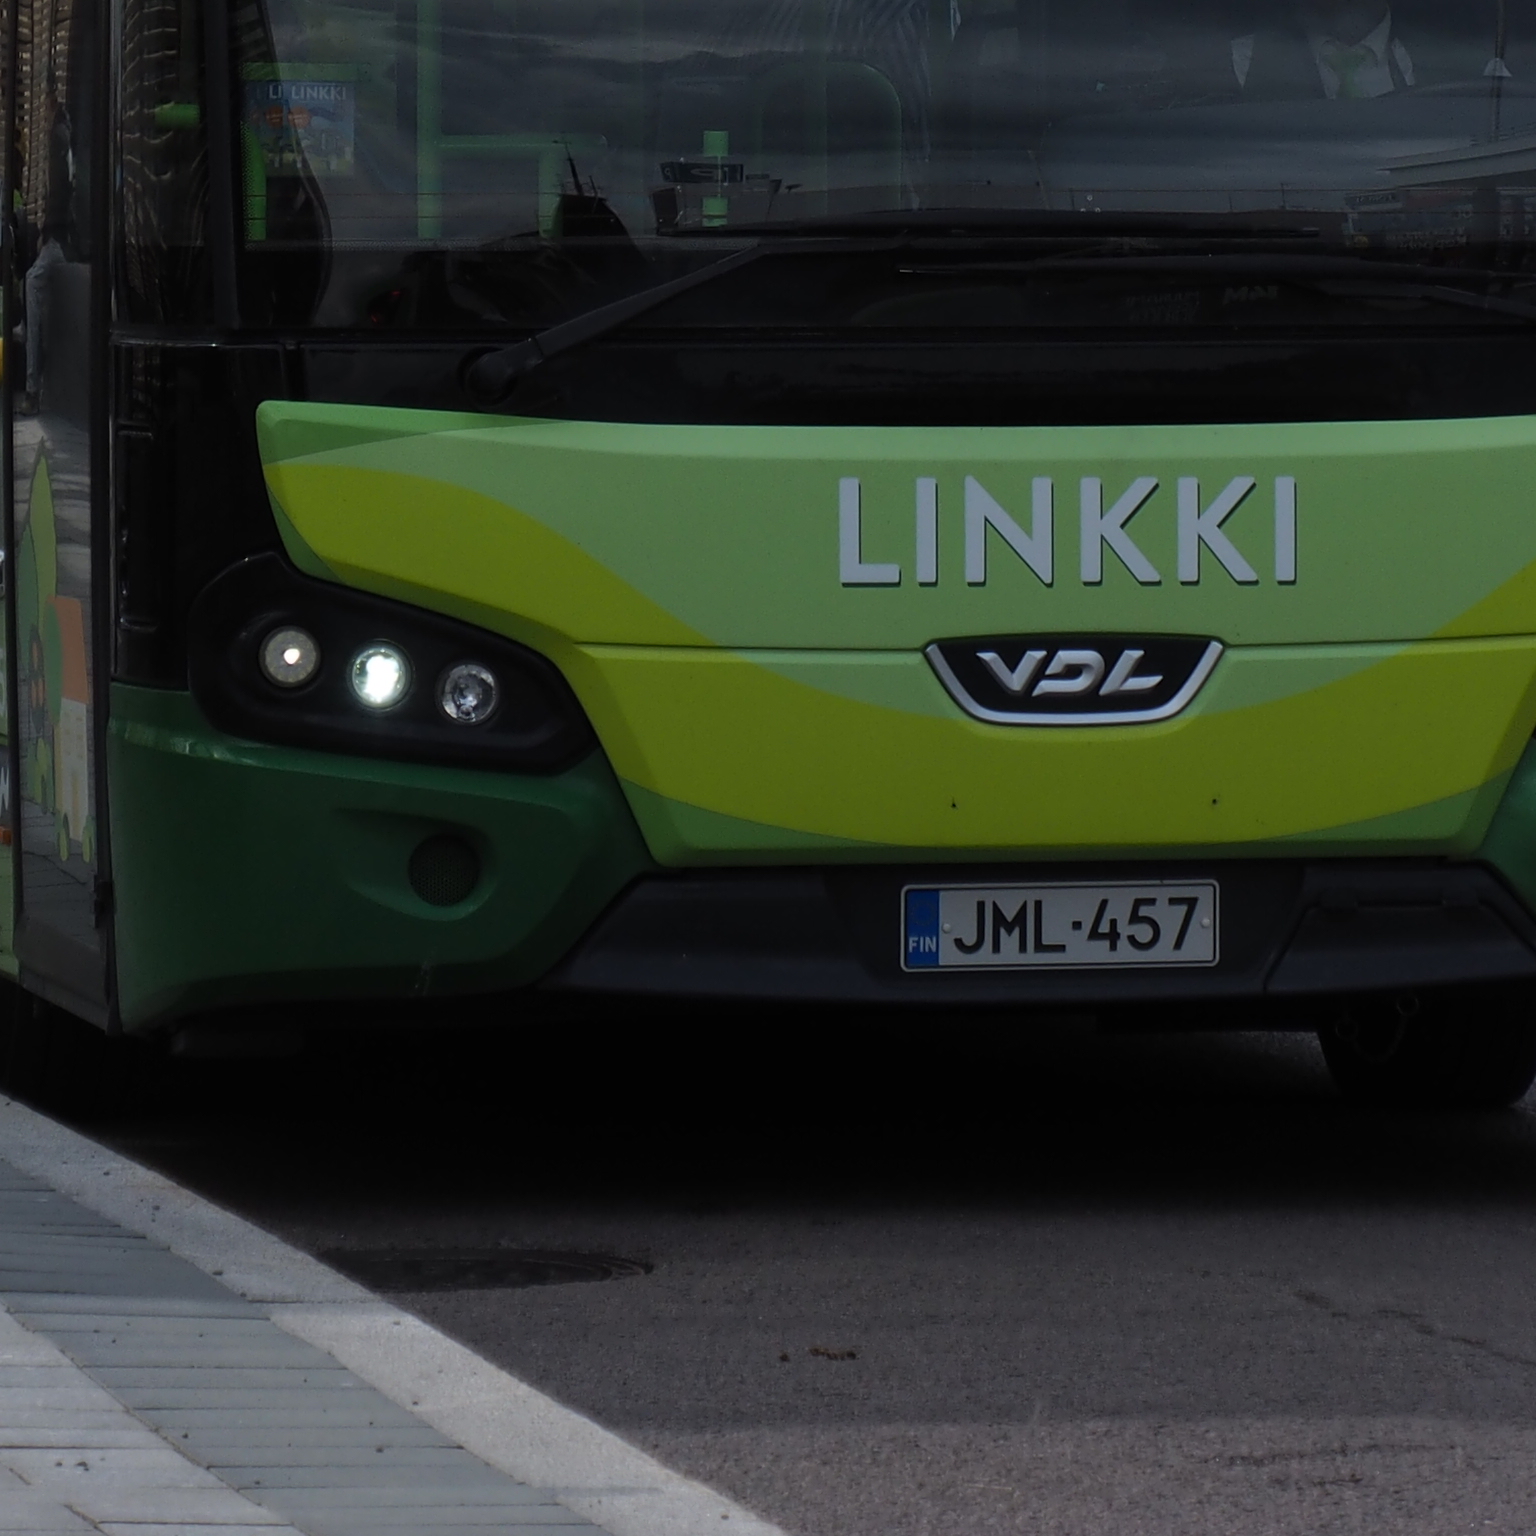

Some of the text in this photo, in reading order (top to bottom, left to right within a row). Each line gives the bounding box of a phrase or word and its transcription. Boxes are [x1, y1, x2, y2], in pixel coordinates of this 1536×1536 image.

[291, 84, 347, 100] LINKKI
[839, 475, 1297, 587] LINKKI
[975, 648, 1164, 697] VDL
[908, 935, 937, 953] FIN
[953, 896, 1200, 954] JML-457
